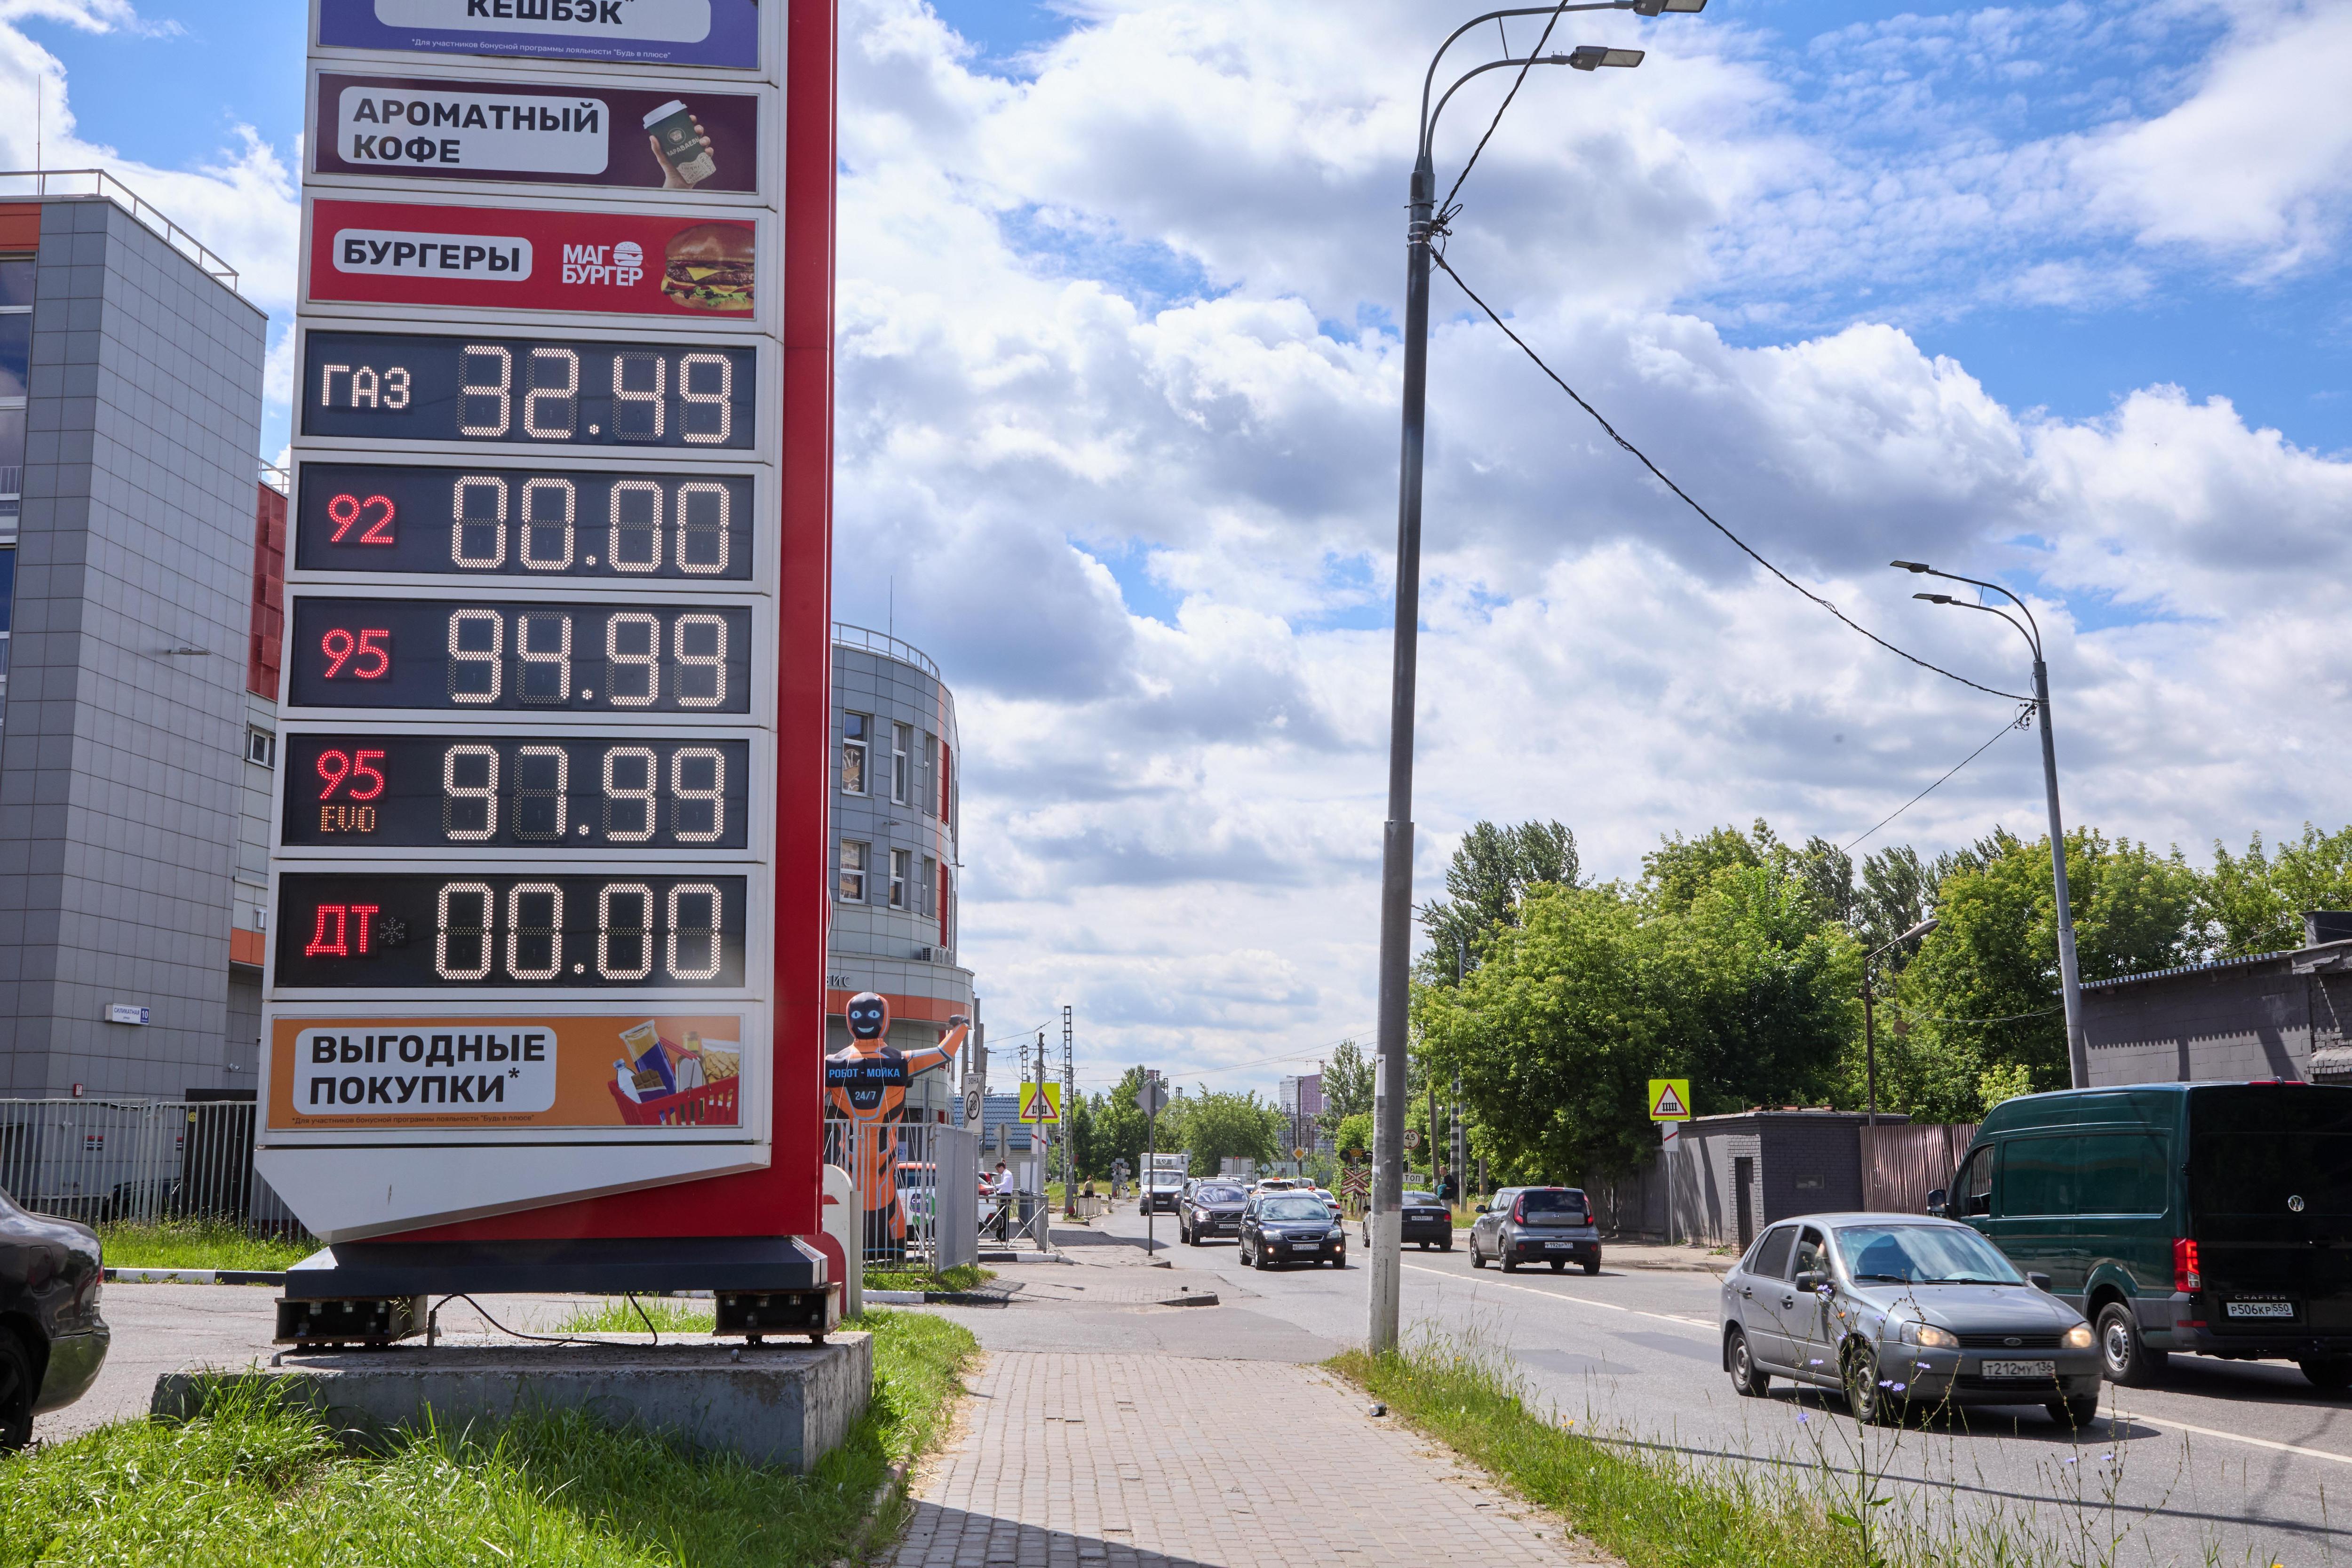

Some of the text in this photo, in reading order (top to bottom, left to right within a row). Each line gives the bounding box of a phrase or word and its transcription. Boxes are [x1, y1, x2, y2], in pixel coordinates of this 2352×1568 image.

[468, 0, 634, 24] КЕШБЭК
[353, 98, 599, 134] АРОМАТНЫЙ
[353, 134, 461, 163] КОФЕ
[343, 239, 520, 272] БУРГЕРЫ
[563, 244, 610, 264] МАГ
[562, 264, 644, 286] БУРГЕР
[322, 345, 731, 444] ГАЗ 32.49
[328, 476, 731, 574] 92 00.00
[322, 609, 728, 707] 95 94.99
[317, 744, 725, 842] 95 97.99
[320, 805, 376, 833] EVO
[305, 882, 722, 980] ДТ 00.00
[142, 1010, 148, 1019] 10
[311, 1034, 546, 1067] ВЫГОДНЫЕ
[829, 1068, 858, 1078] РОБОТ
[867, 1067, 900, 1078] МОЙКА
[855, 1091, 876, 1100] 24/7
[2231, 1305, 2271, 1314] Р506КР
[1986, 1362, 2053, 1375] Т212МУ 136
